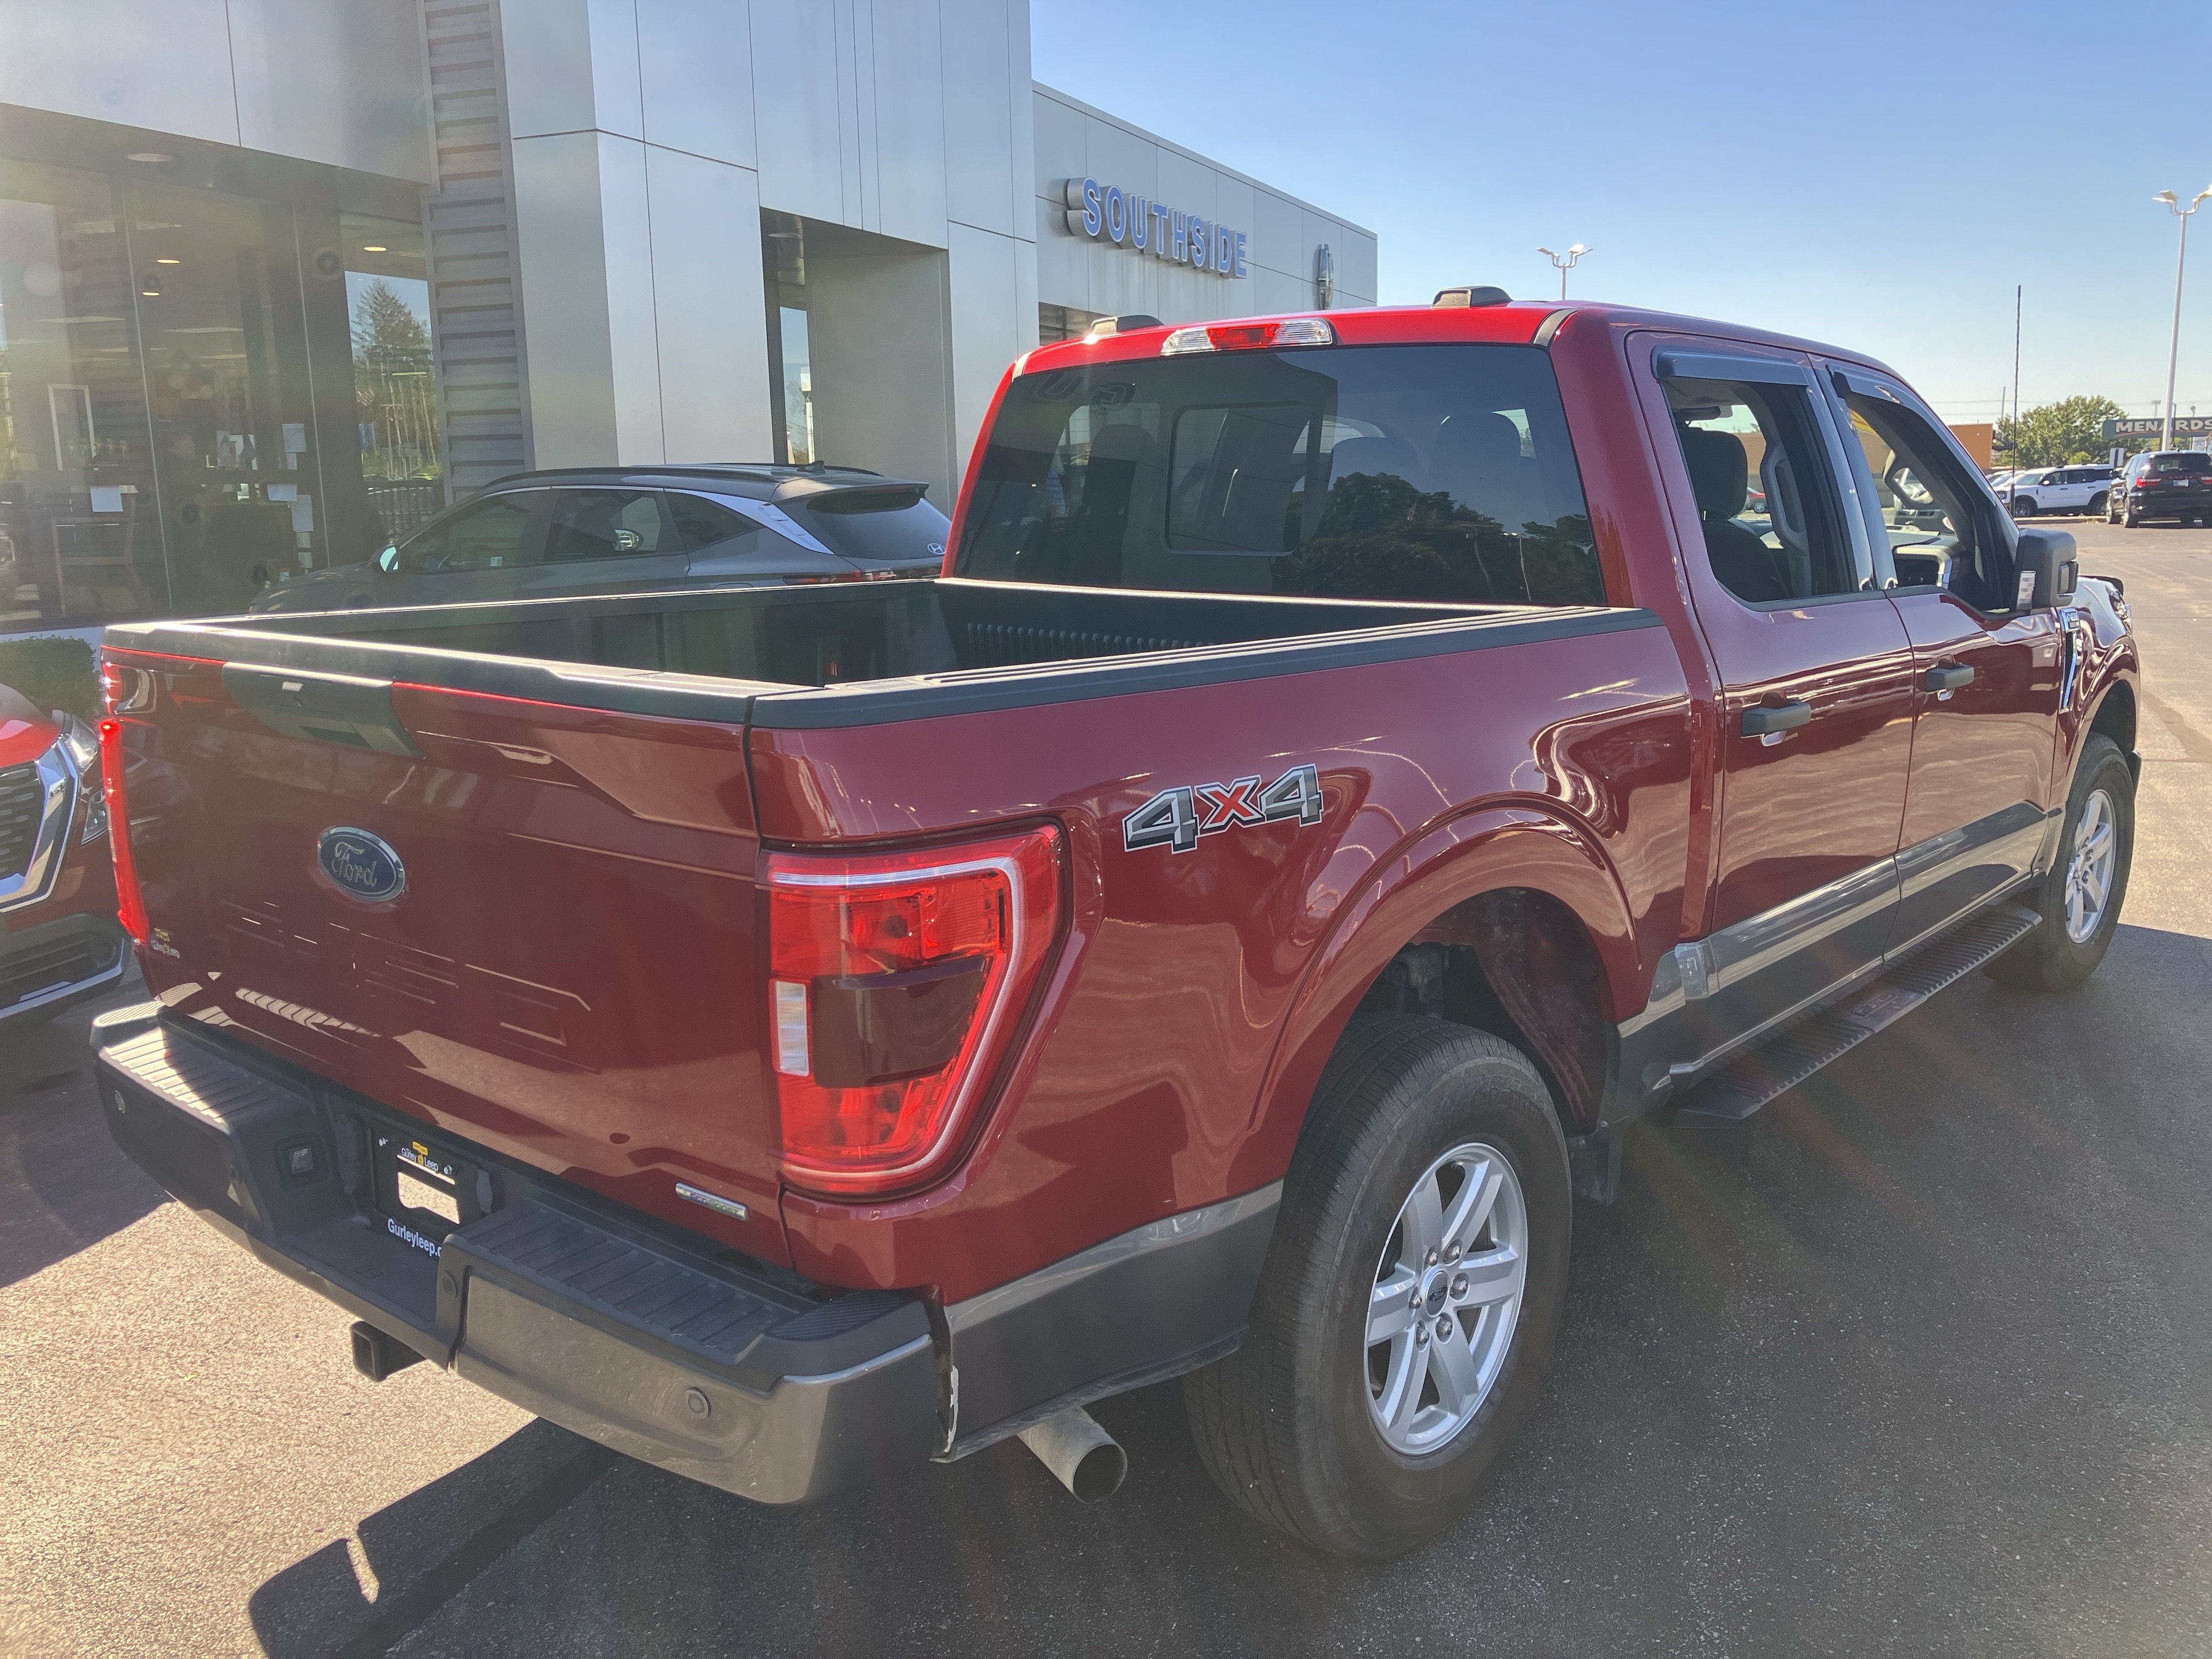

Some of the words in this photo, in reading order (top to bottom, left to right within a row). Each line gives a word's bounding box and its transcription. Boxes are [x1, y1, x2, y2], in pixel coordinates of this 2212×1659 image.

[1074, 177, 1247, 279] SOUTHSIDE
[332, 842, 377, 887] Ford
[401, 1147, 417, 1162] Gurley
[424, 1155, 439, 1171] Leep
